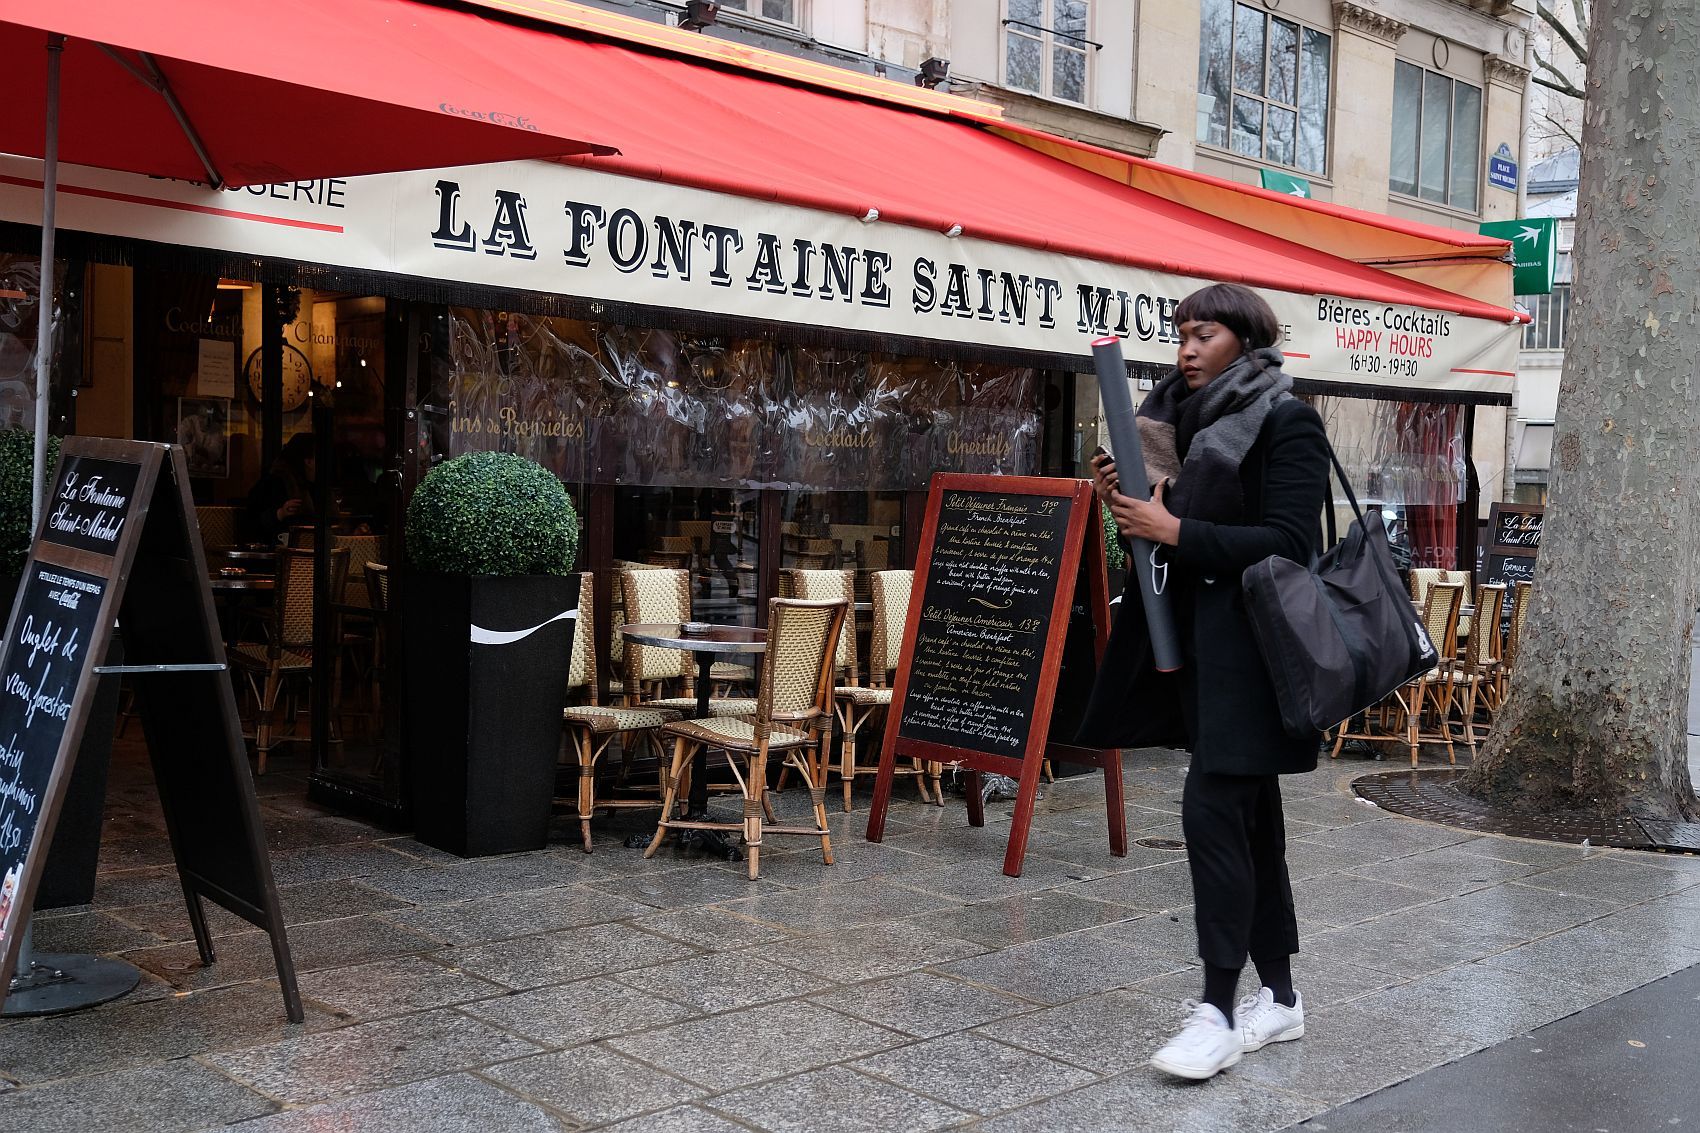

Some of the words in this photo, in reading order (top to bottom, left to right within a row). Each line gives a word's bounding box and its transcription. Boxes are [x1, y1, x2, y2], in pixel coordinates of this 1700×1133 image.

[431, 179, 538, 260] LA
[563, 201, 892, 308] FONTAINE
[912, 256, 1062, 329] SAINT
[1076, 283, 1181, 344] MICH
[1318, 298, 1370, 326] Bières
[1383, 307, 1450, 336] Cocktails
[294, 321, 380, 356] Champagne
[1336, 327, 1382, 352] HAPPY
[1390, 333, 1433, 358] HOURS
[1350, 353, 1381, 373] 16H30
[1388, 358, 1418, 377] 19H30
[487, 419, 500, 434] de
[60, 471, 79, 500] La
[79, 475, 126, 509] Fontaine
[50, 502, 124, 541] Saint-Michel
[1504, 515, 1518, 529] La
[1502, 557, 1527, 573] FORMULE
[62, 627, 78, 661] de
[26, 661, 72, 728] forestier
